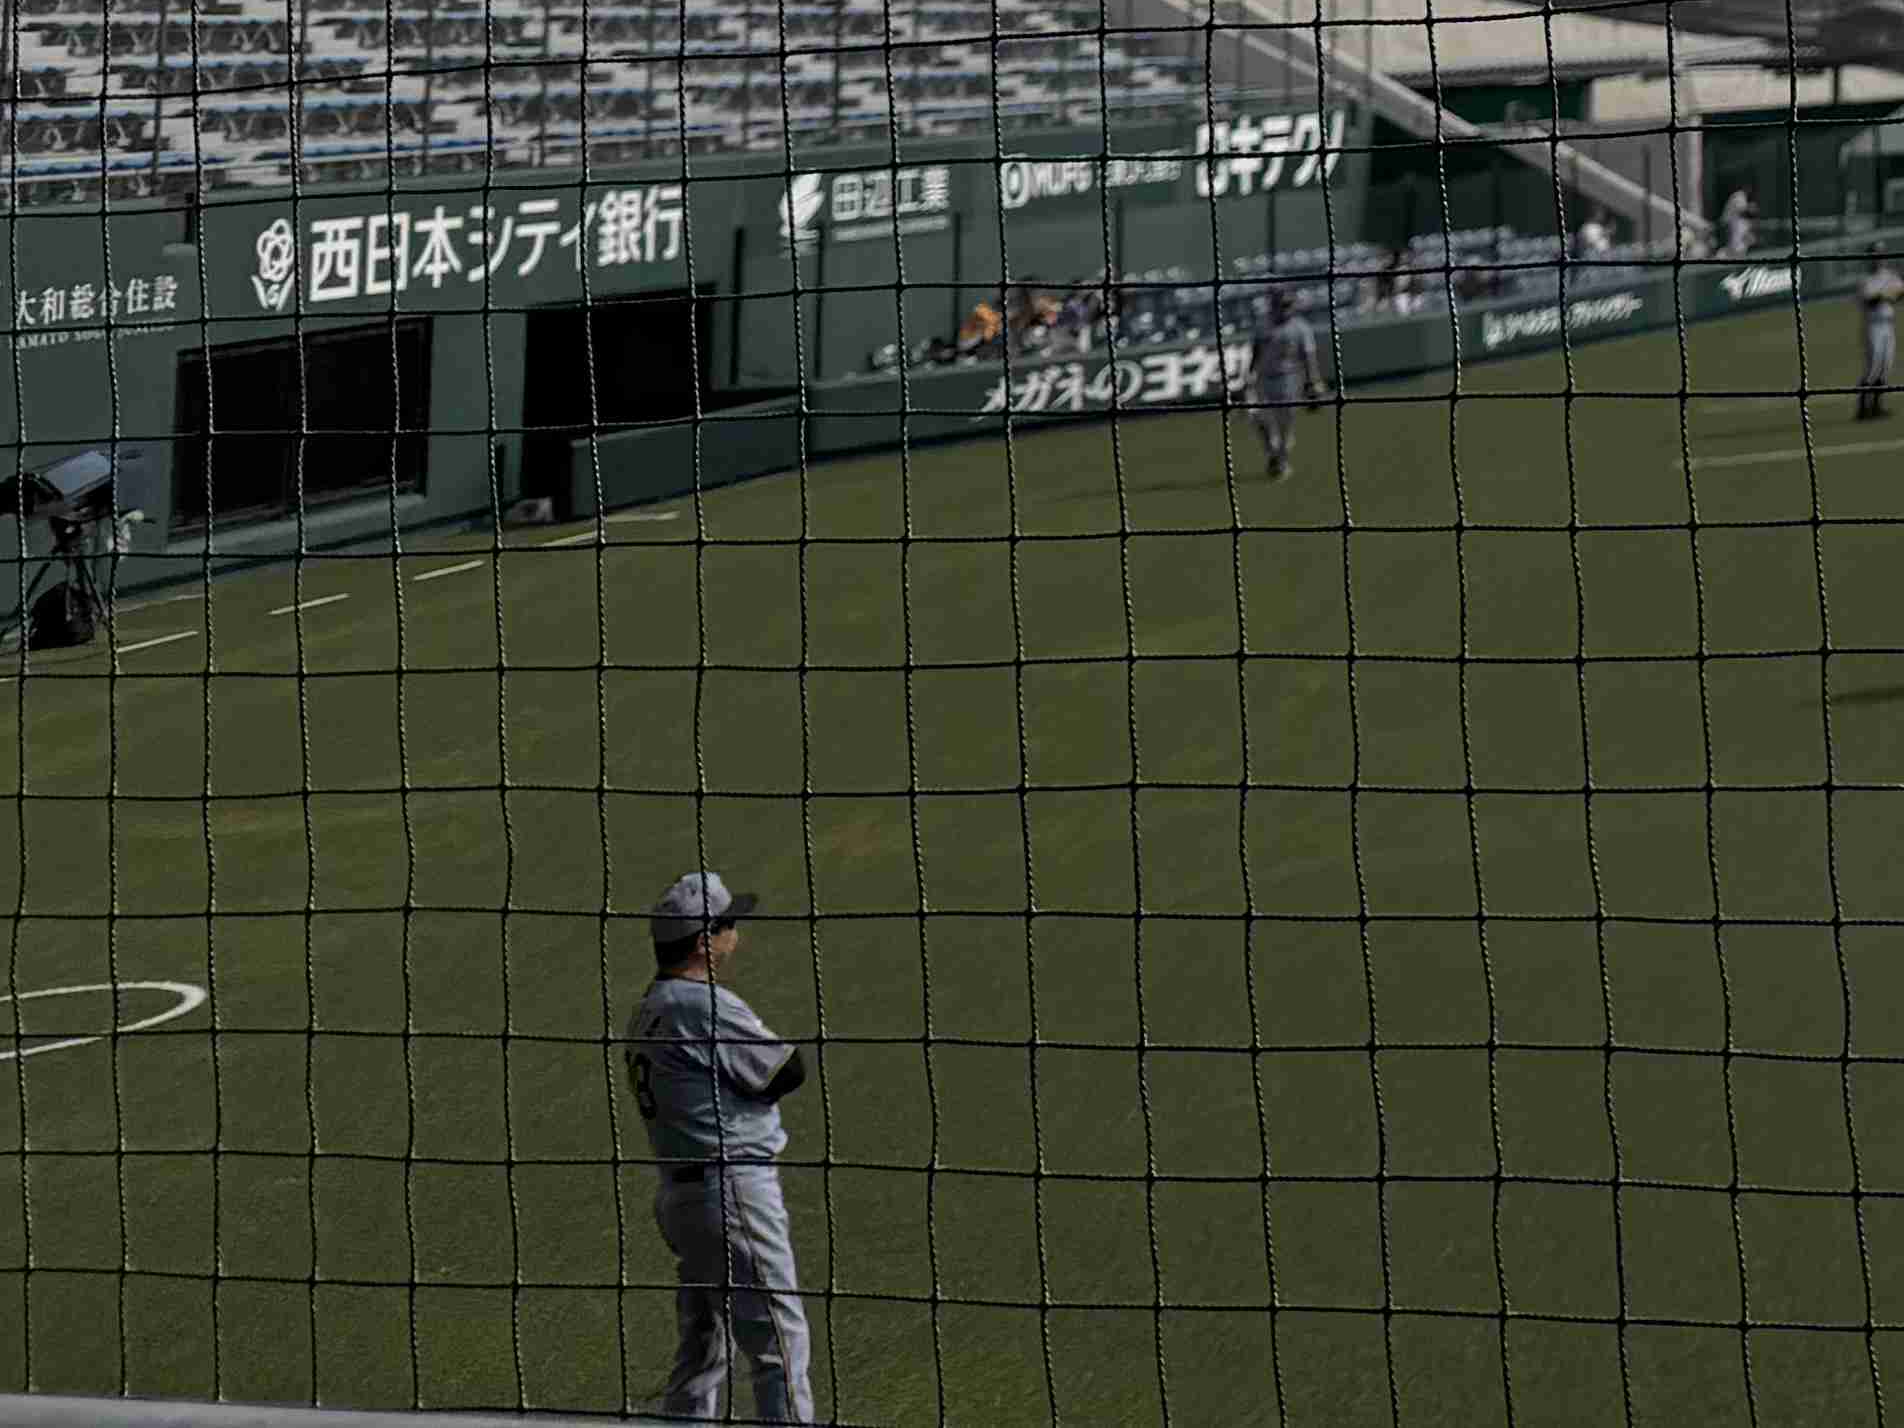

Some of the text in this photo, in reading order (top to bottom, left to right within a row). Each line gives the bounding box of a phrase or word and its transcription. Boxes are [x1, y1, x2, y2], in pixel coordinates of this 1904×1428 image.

[308, 184, 685, 302] 西日本シティ銀行
